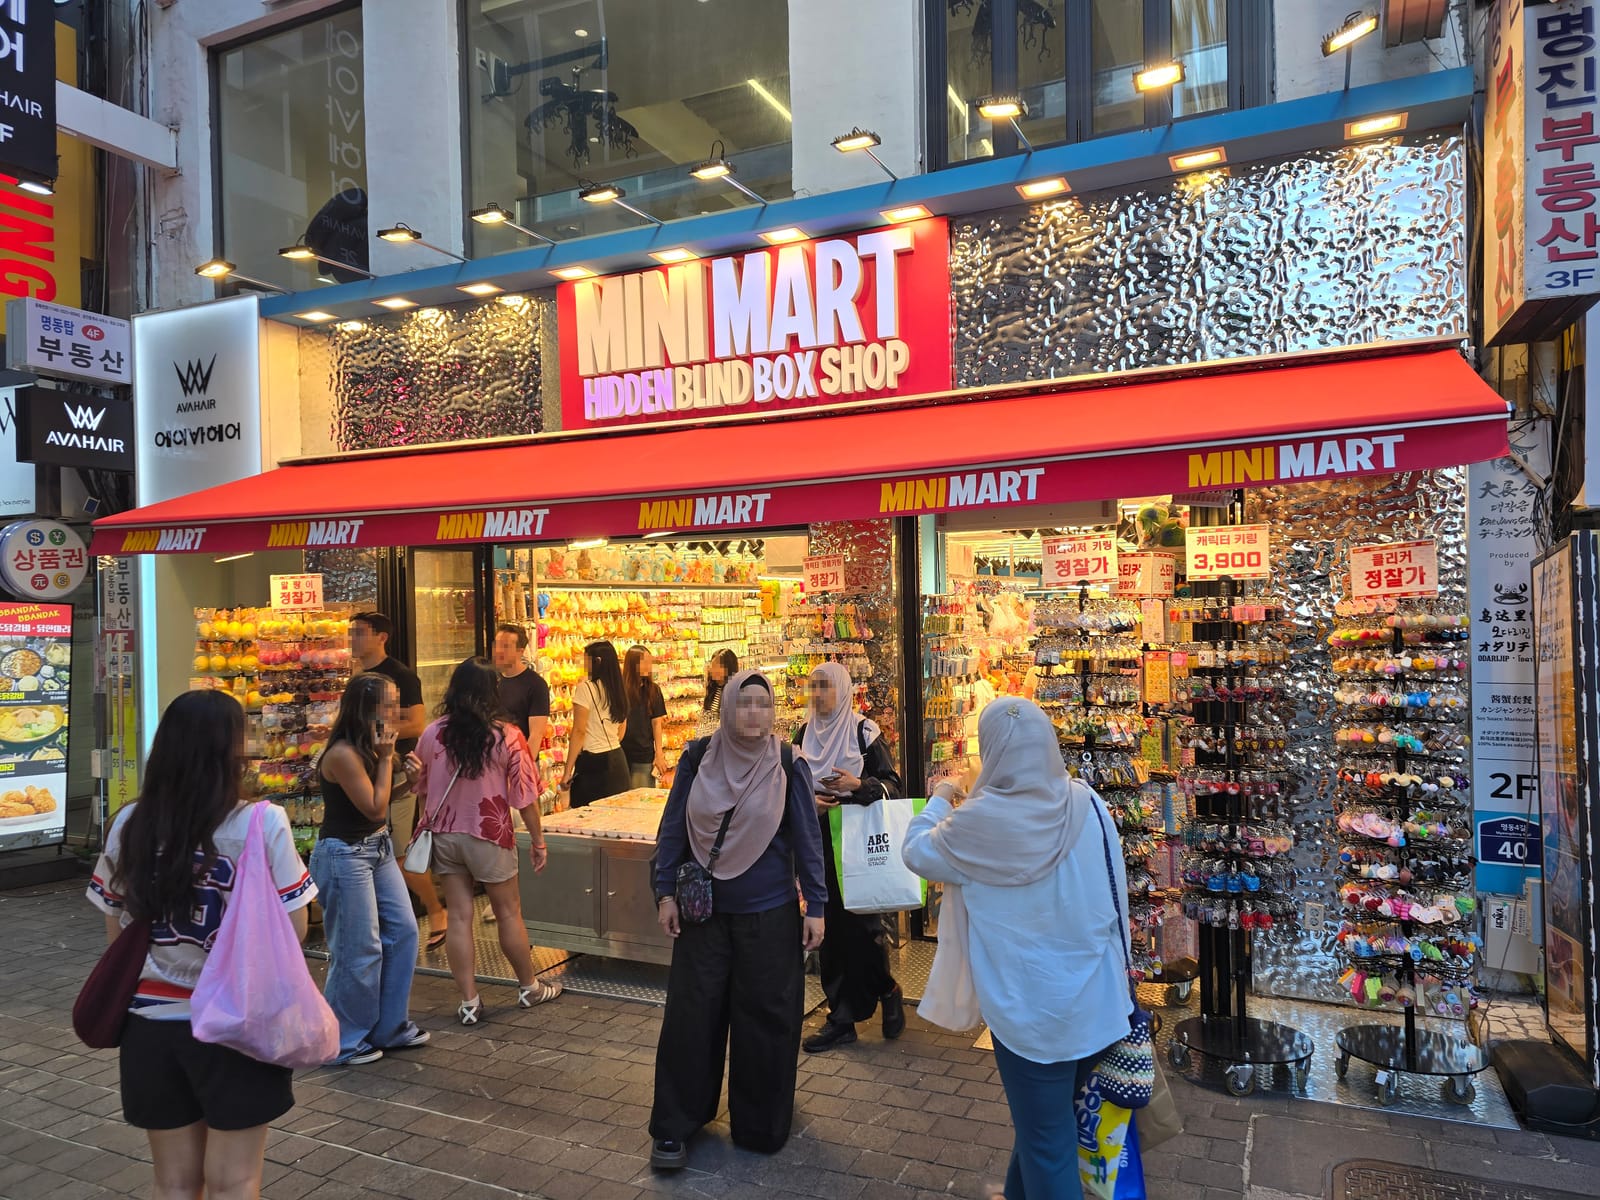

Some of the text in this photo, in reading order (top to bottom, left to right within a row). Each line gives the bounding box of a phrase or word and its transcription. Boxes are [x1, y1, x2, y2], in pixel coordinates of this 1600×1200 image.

[1544, 268, 1596, 290] 3F
[574, 227, 915, 376] MINI MART
[41, 315, 75, 336] 명동탑
[86, 328, 100, 339] 4F
[36, 335, 125, 375] 부동산
[583, 339, 910, 421] HIDDEN BLIND BOX SHOP
[1188, 434, 1405, 488] MINI MART
[879, 467, 1045, 513] MINI MART
[638, 493, 772, 530] MINI MART
[266, 520, 364, 548] MINI MART
[436, 508, 550, 541] MINI MART
[121, 528, 207, 552] MINI MART
[1092, 539, 1113, 551] 키링
[1196, 533, 1258, 546] 캐릭터 키링
[13, 547, 85, 572] 상품권
[1054, 556, 1110, 577] 정찰가
[1193, 551, 1262, 572] 3,900
[1489, 551, 1530, 559] Produced
[1504, 559, 1515, 567] by
[1365, 566, 1426, 589] 정찰가
[116, 559, 132, 629] 부동산
[18, 610, 61, 622] BBANDAK
[1489, 772, 1538, 800] 2F
[867, 833, 889, 846] ABC
[867, 845, 890, 854] MART
[1497, 841, 1528, 860] 40
